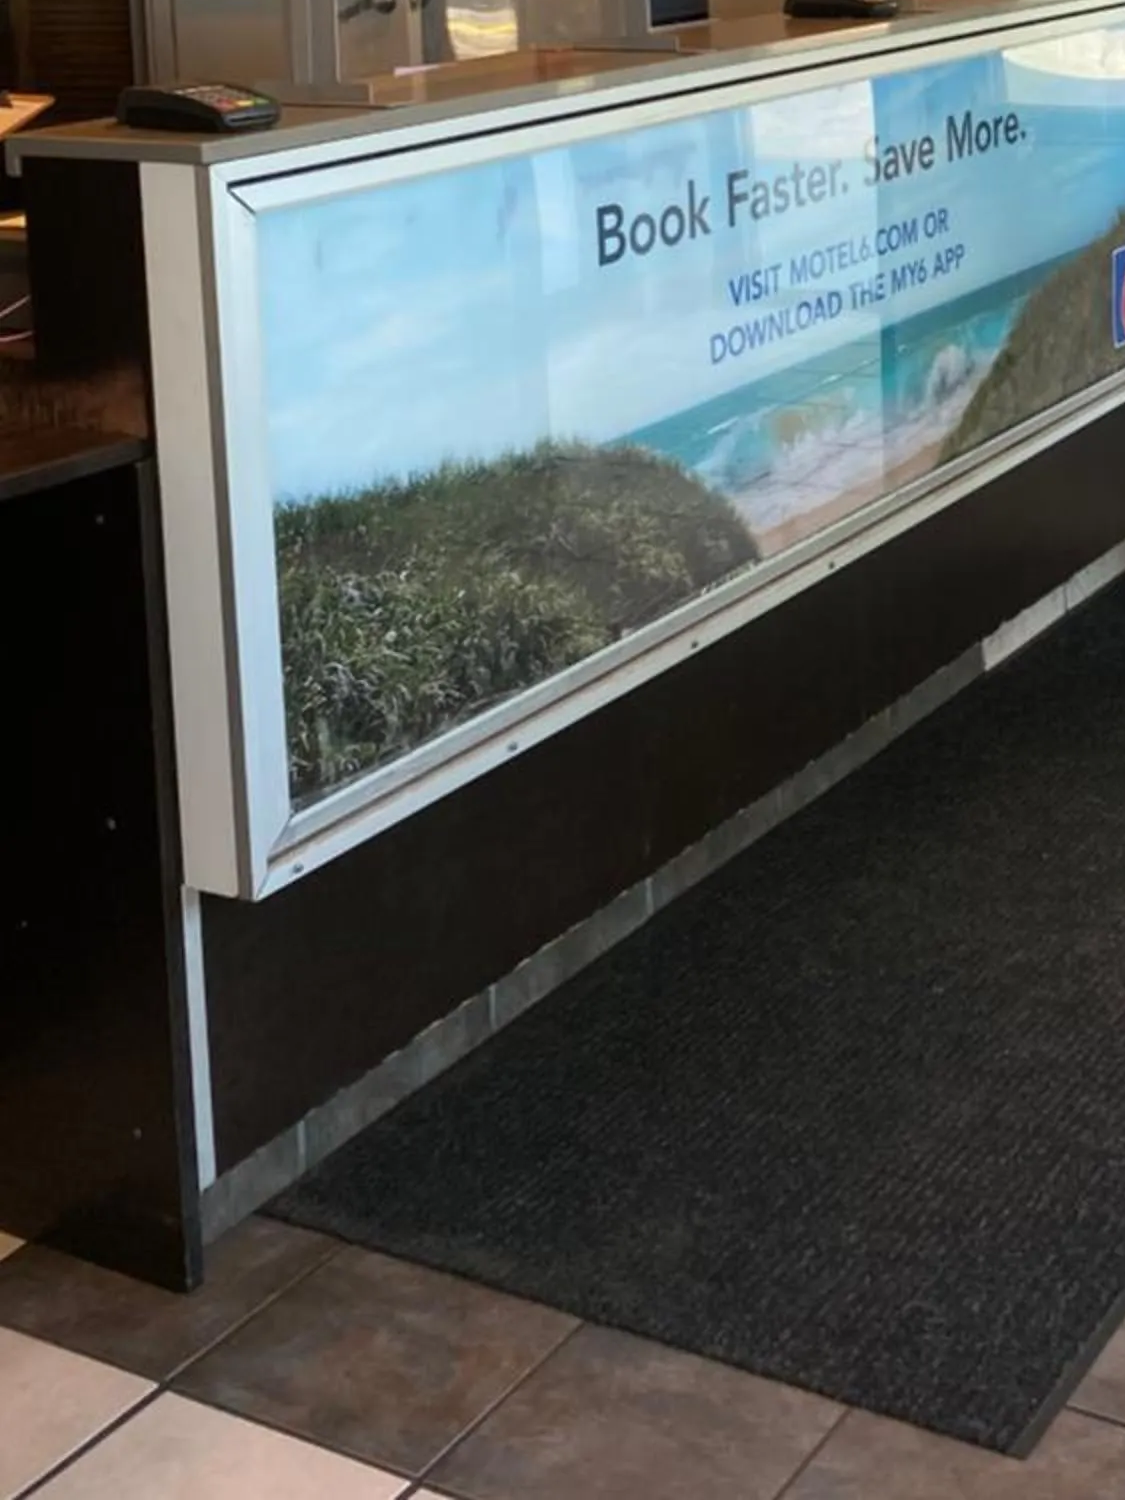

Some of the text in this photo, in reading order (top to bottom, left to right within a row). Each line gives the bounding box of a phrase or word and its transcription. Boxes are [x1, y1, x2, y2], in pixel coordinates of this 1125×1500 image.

[596, 110, 1026, 267] Book Faster. Save More.
[710, 243, 966, 364] DOWNLOAD THE MY6 APP
[729, 208, 950, 306] VISIT MOTEL6.COM OR
